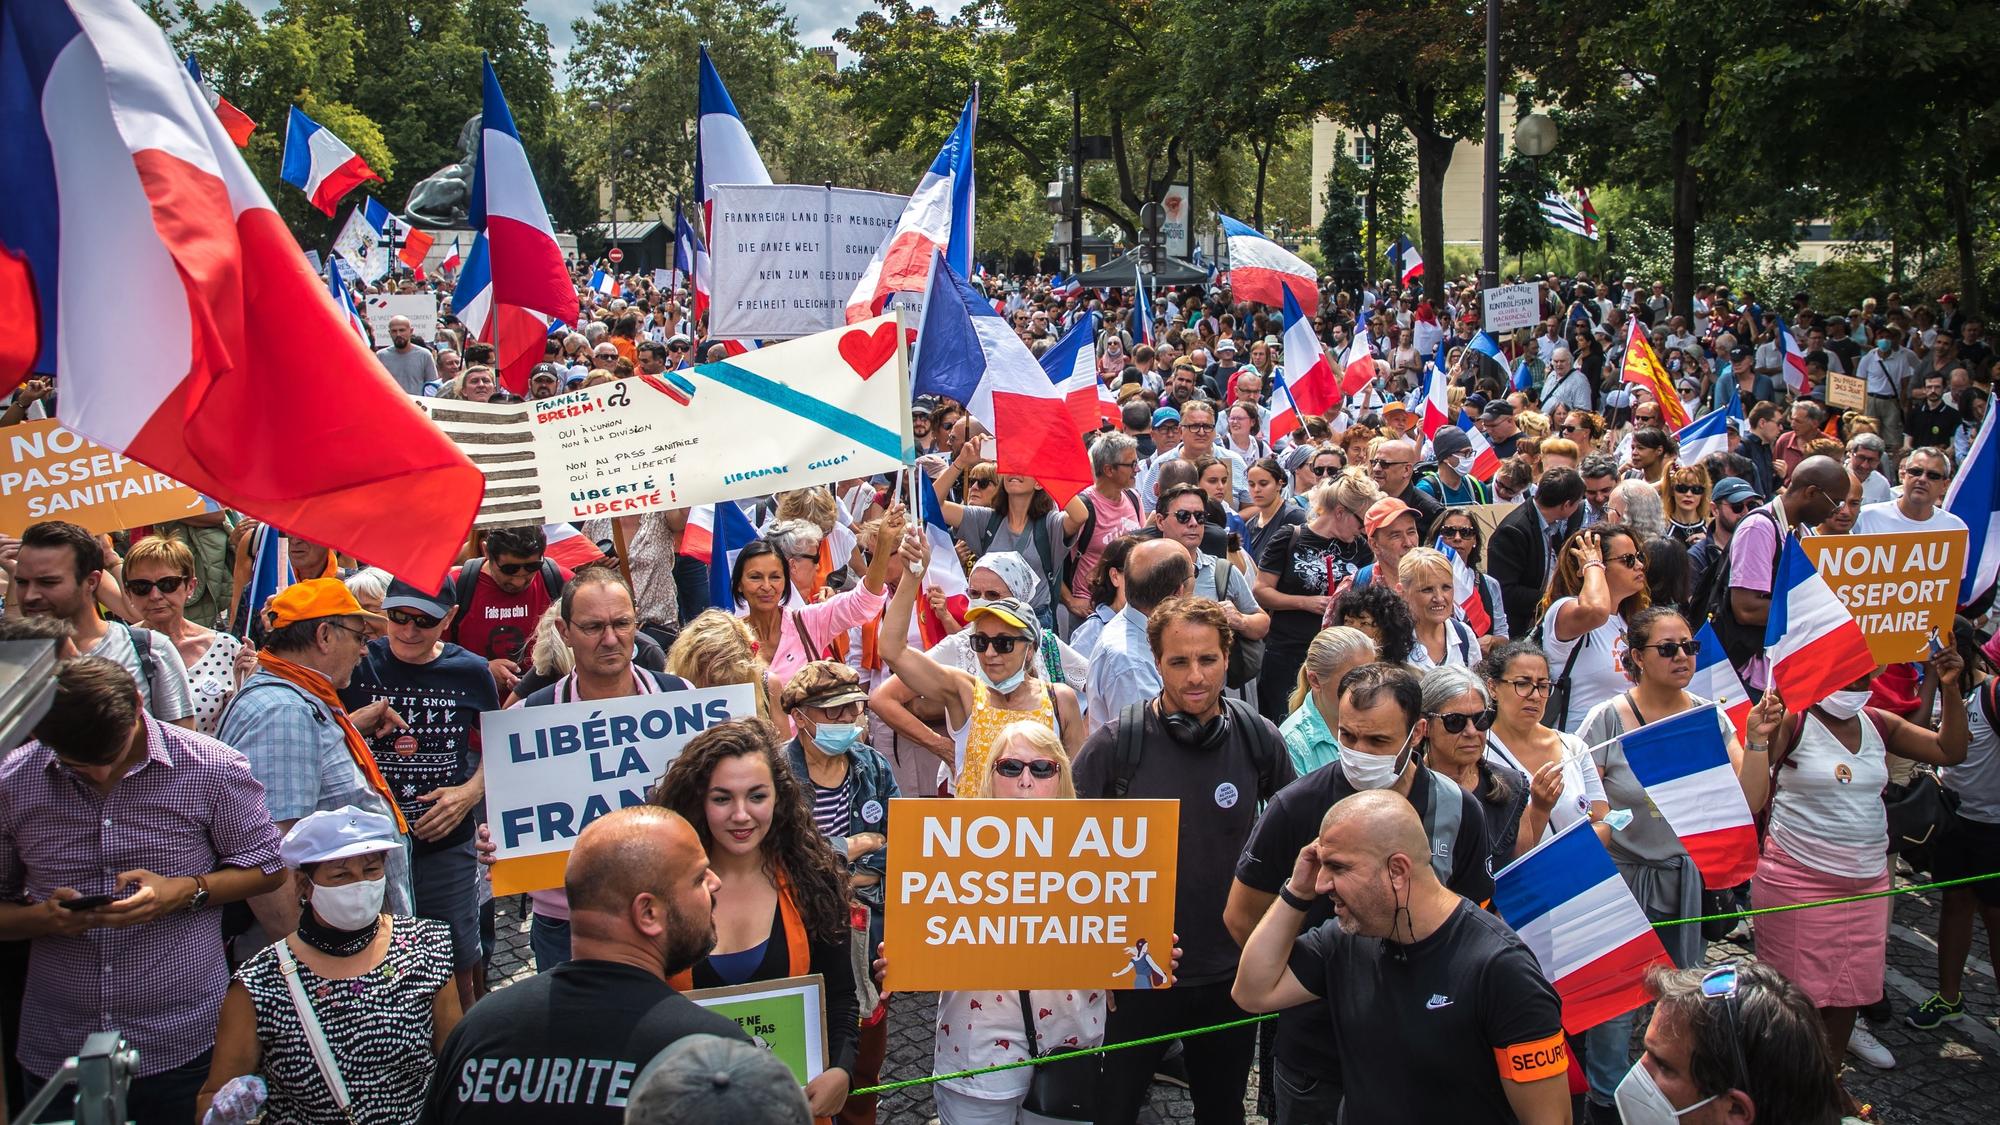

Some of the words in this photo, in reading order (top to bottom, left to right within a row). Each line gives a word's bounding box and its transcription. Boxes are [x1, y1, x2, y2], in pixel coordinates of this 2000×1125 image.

[725, 212, 785, 223] FRANKREICH
[792, 213, 818, 223] LAND
[738, 243, 756, 253] DIE
[761, 242, 790, 252] GANZE
[796, 242, 819, 253] WELT
[760, 270, 781, 280] NEIN
[789, 270, 809, 280] ZUM
[1491, 286, 1531, 300] BIENVENUE
[738, 299, 786, 310] FREIHEIT
[558, 431, 576, 440] OUI
[10, 427, 98, 463] NO
[566, 461, 587, 471] NON
[596, 457, 609, 466] AU
[615, 450, 646, 462] PASS
[1, 452, 150, 496] PASSEP
[608, 467, 621, 475] LA
[573, 490, 663, 516] LIBERTÉ
[1818, 545, 1897, 577] NON
[1902, 542, 1950, 573] AU
[1835, 579, 1950, 608] SSEPORT
[485, 606, 499, 619] Fais
[500, 607, 511, 620] pas
[402, 697, 416, 706] IT
[422, 697, 456, 707] SNOW
[508, 699, 732, 764] LIBÉRONS
[589, 746, 650, 782] LA
[922, 816, 1054, 858] NON
[1068, 816, 1148, 858] AU
[901, 870, 1157, 904] PASSEPORT
[925, 915, 1127, 945] SANITAIRE
[1430, 993, 1449, 1004] NIKE
[747, 1015, 761, 1026] NE
[754, 1023, 776, 1036] PAS
[458, 1058, 637, 1107] SECURITE
